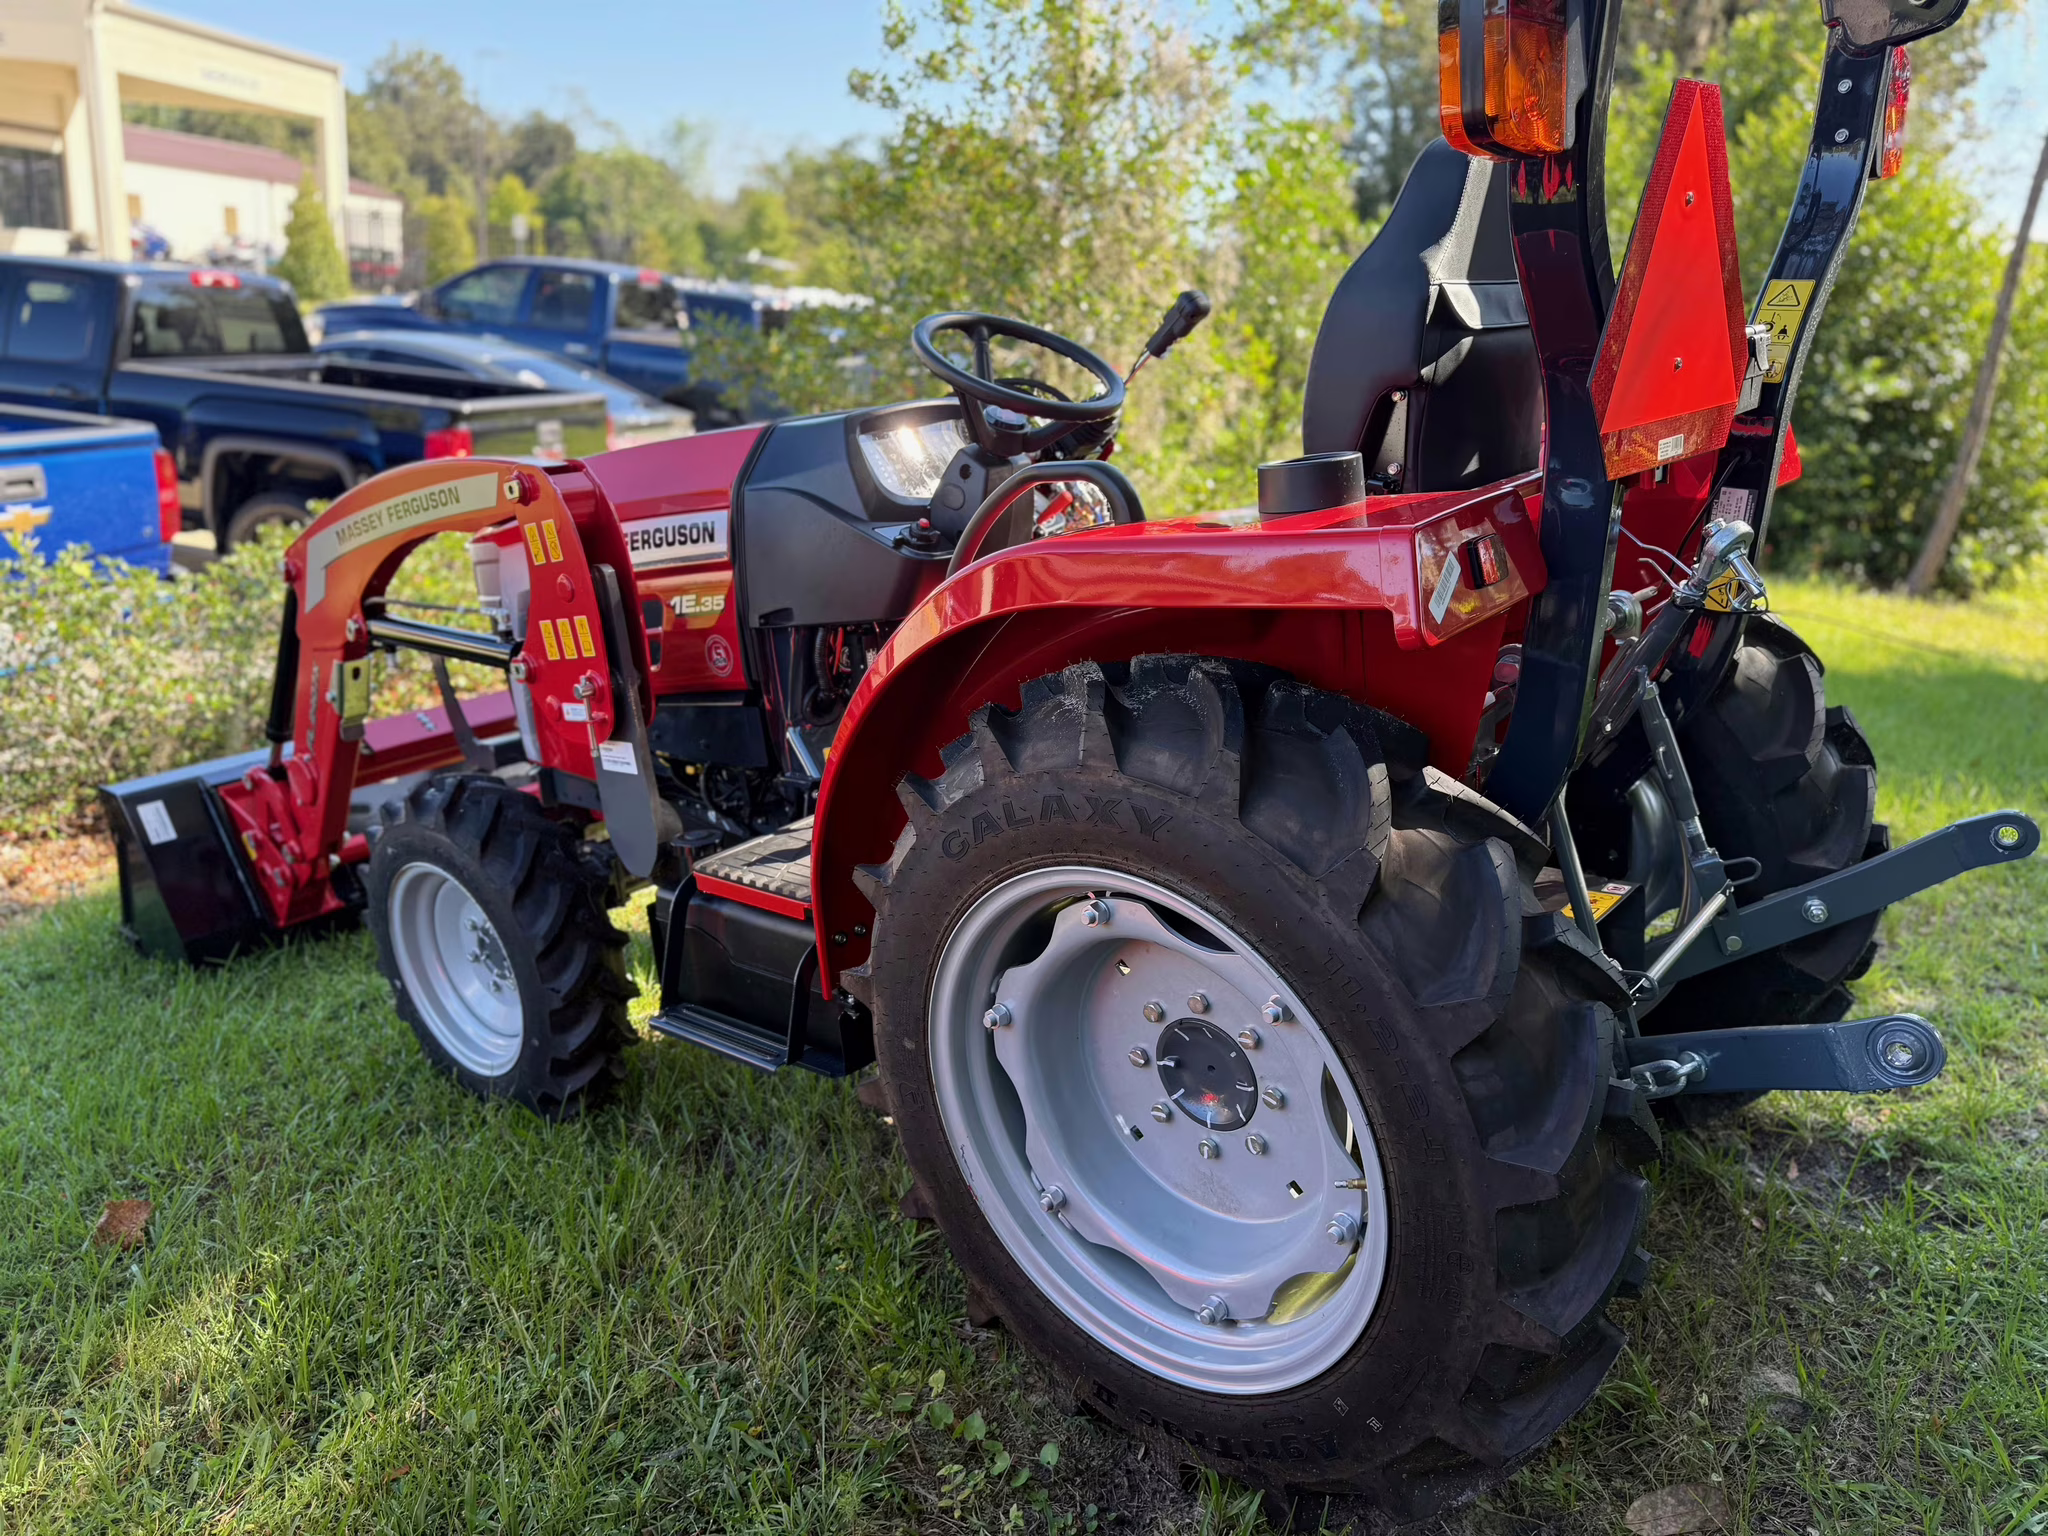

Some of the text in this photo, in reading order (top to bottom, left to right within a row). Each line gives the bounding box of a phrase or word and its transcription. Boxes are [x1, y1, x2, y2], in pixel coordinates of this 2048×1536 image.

[336, 487, 460, 544] MASSEY FERGUSON
[669, 594, 726, 615] 1E.35
[941, 793, 1174, 863] GALAXY
